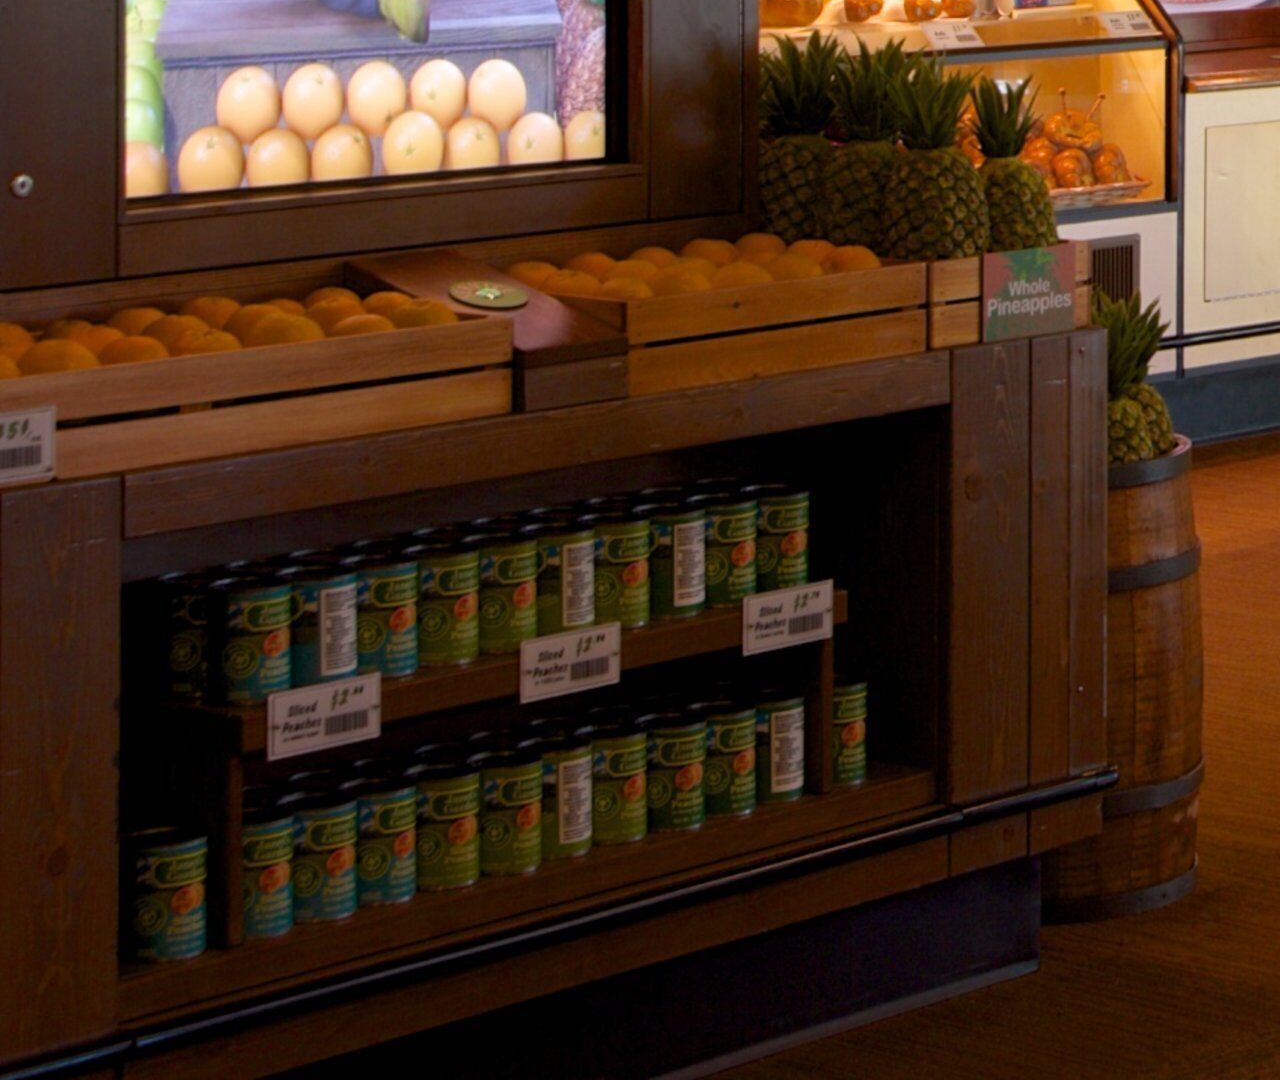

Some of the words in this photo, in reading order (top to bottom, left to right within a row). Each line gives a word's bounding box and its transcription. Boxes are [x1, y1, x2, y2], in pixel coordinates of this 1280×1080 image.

[1008, 277, 1051, 297] Whole
[986, 292, 1073, 318] Pineapples
[759, 603, 783, 618] Sliced
[754, 618, 787, 632] Peaches
[538, 647, 565, 663] Sliced
[532, 663, 568, 678] Peaches
[287, 700, 319, 718] Sliced
[281, 717, 322, 734] Peaches
